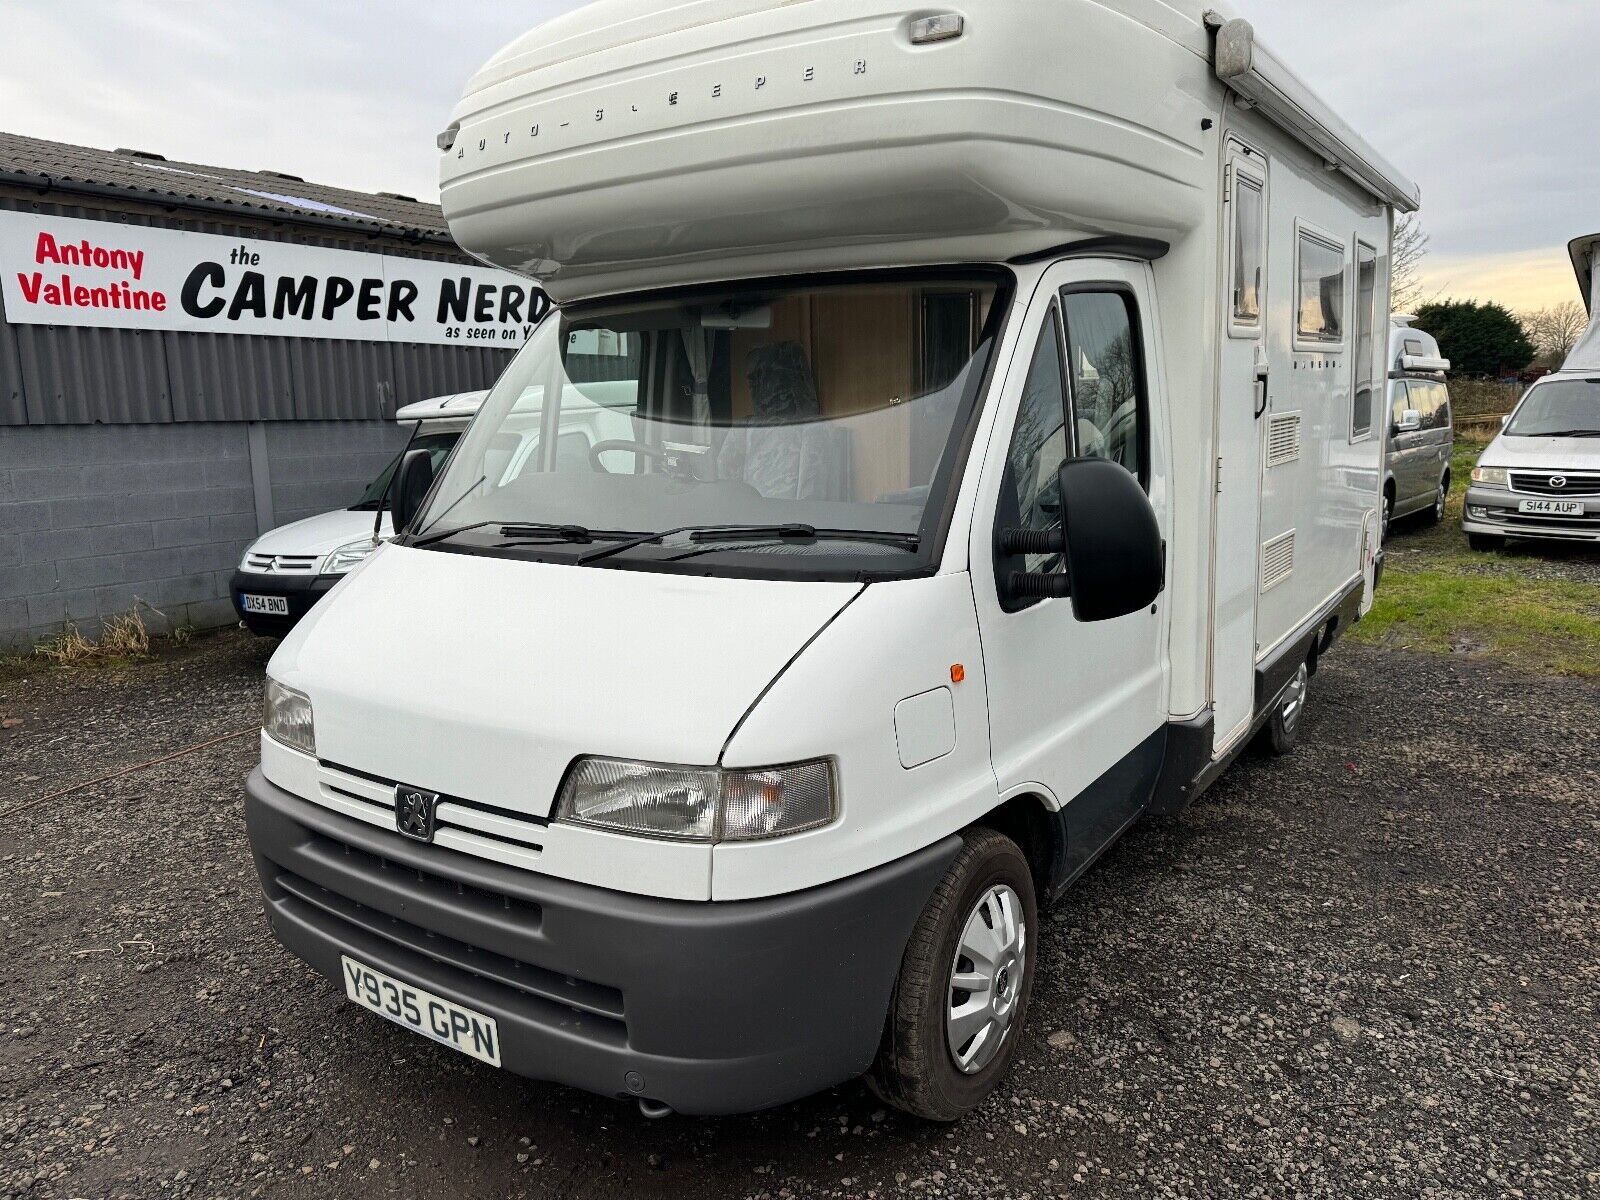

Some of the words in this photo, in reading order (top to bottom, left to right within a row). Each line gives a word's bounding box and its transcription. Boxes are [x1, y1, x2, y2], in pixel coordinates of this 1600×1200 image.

[35, 232, 144, 280] Antony
[230, 245, 260, 266] the
[17, 272, 166, 311] Valentine
[180, 261, 418, 322] CAMPER
[445, 327, 460, 338] as
[466, 327, 496, 339] seen
[501, 328, 516, 339] on
[1526, 501, 1550, 511] S144
[1554, 503, 1577, 512] AUP
[245, 596, 266, 610] DX54
[267, 598, 286, 611] BND
[345, 962, 421, 1027] Y935
[428, 1000, 495, 1059] GPN
